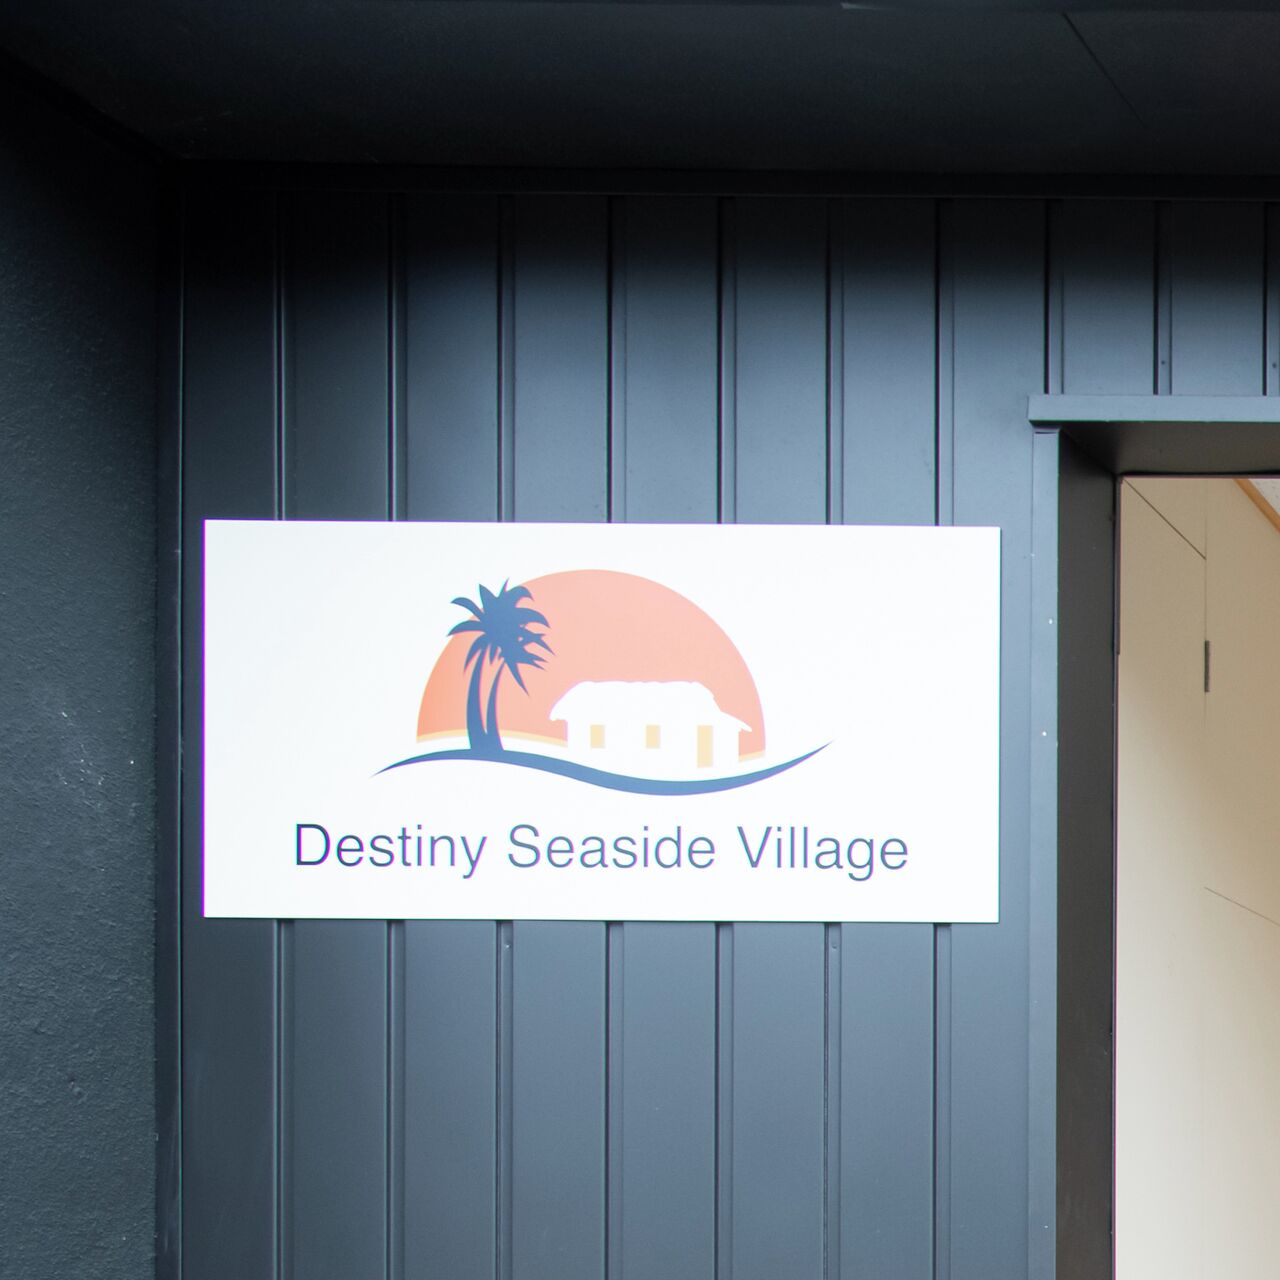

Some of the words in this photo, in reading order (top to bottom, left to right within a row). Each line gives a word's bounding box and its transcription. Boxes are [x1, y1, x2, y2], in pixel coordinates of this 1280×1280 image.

[295, 823, 488, 880] Destiny
[508, 824, 715, 869] Seaside
[736, 825, 909, 882] Village
